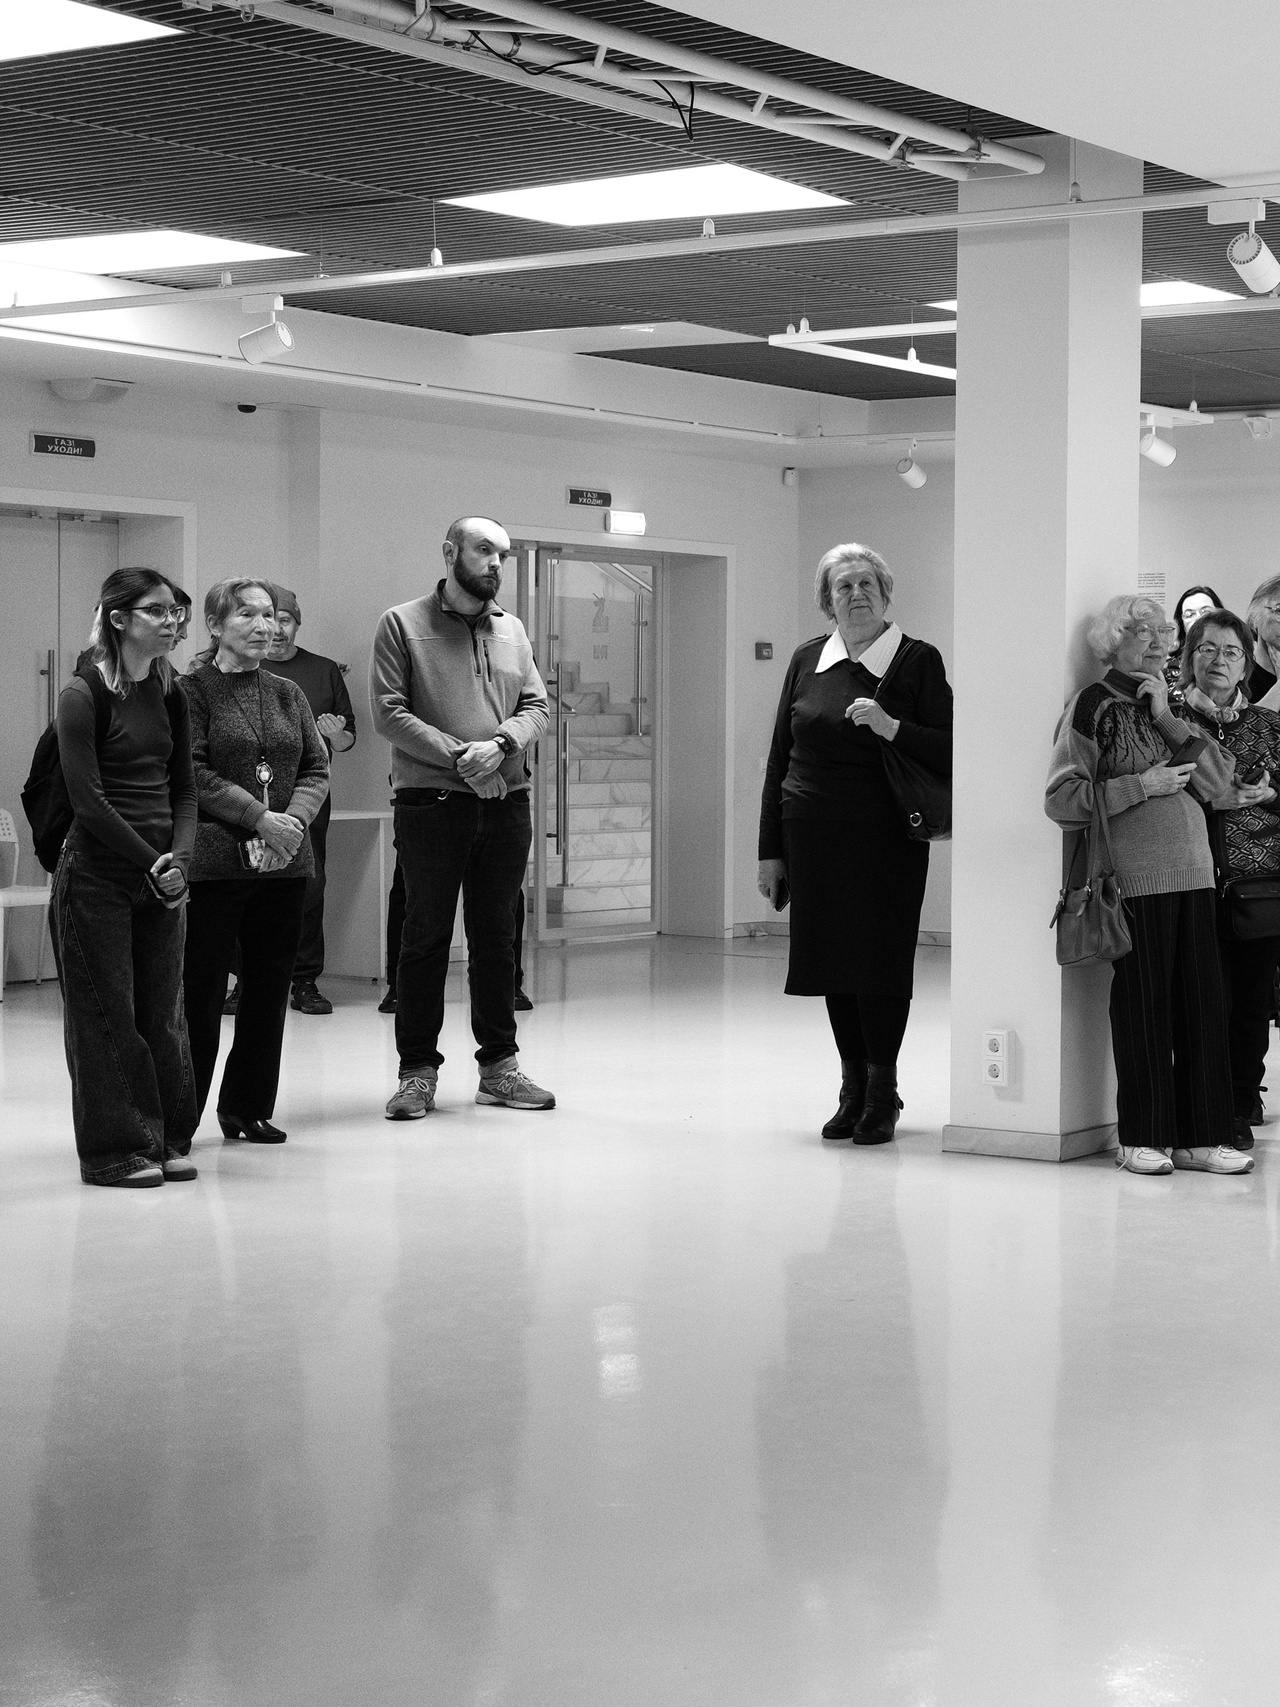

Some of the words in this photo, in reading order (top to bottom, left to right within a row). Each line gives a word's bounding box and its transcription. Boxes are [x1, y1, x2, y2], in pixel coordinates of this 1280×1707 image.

[54, 438, 75, 447] ГАЗ!
[47, 445, 83, 454] УХОДИ!
[578, 497, 603, 505] УХОДИ!
[496, 1079, 513, 1094] N
